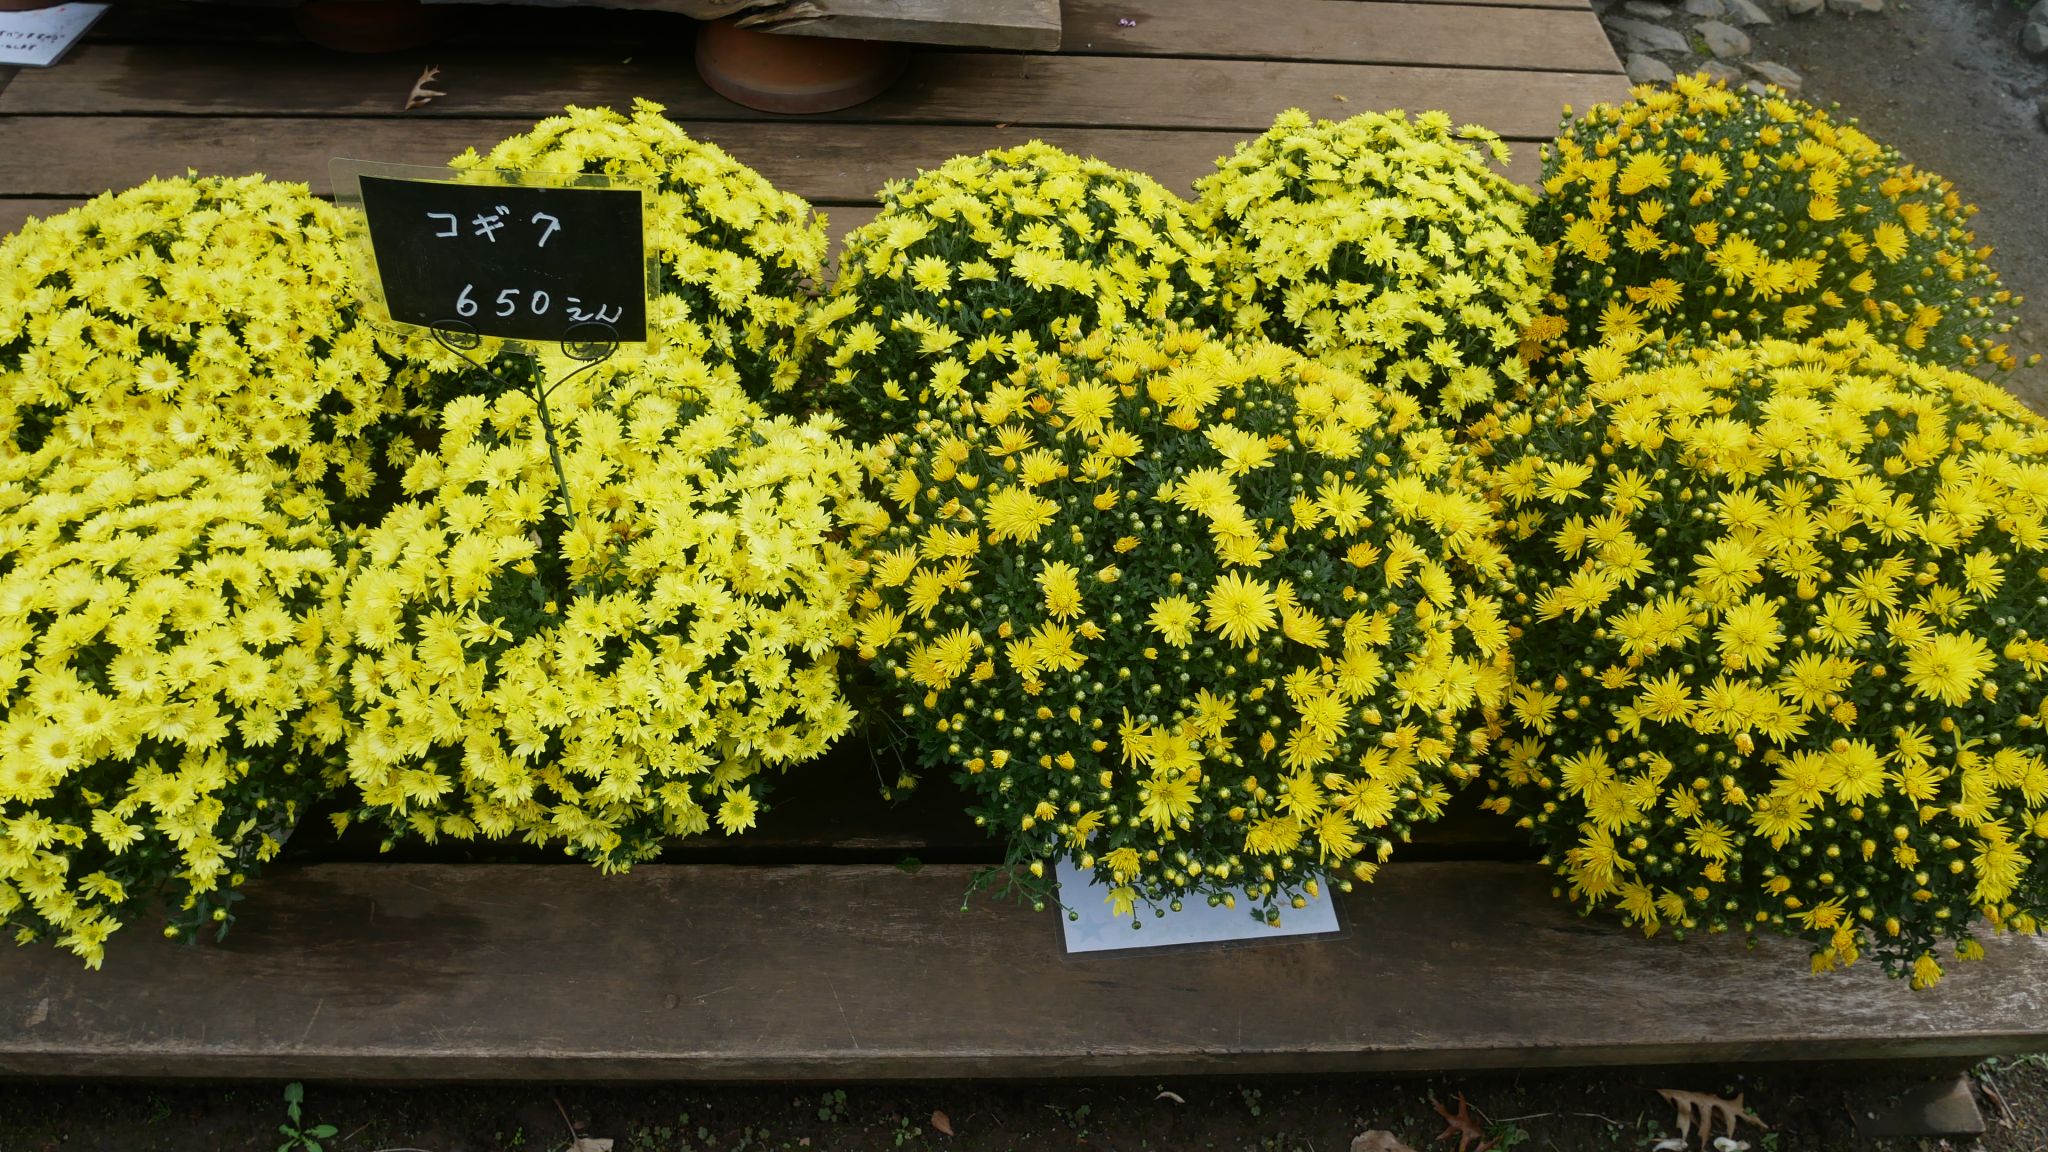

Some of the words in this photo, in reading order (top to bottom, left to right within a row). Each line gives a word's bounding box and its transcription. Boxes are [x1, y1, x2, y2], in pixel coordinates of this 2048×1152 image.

[427, 205, 561, 247] コギク
[456, 284, 623, 323] 650えん
